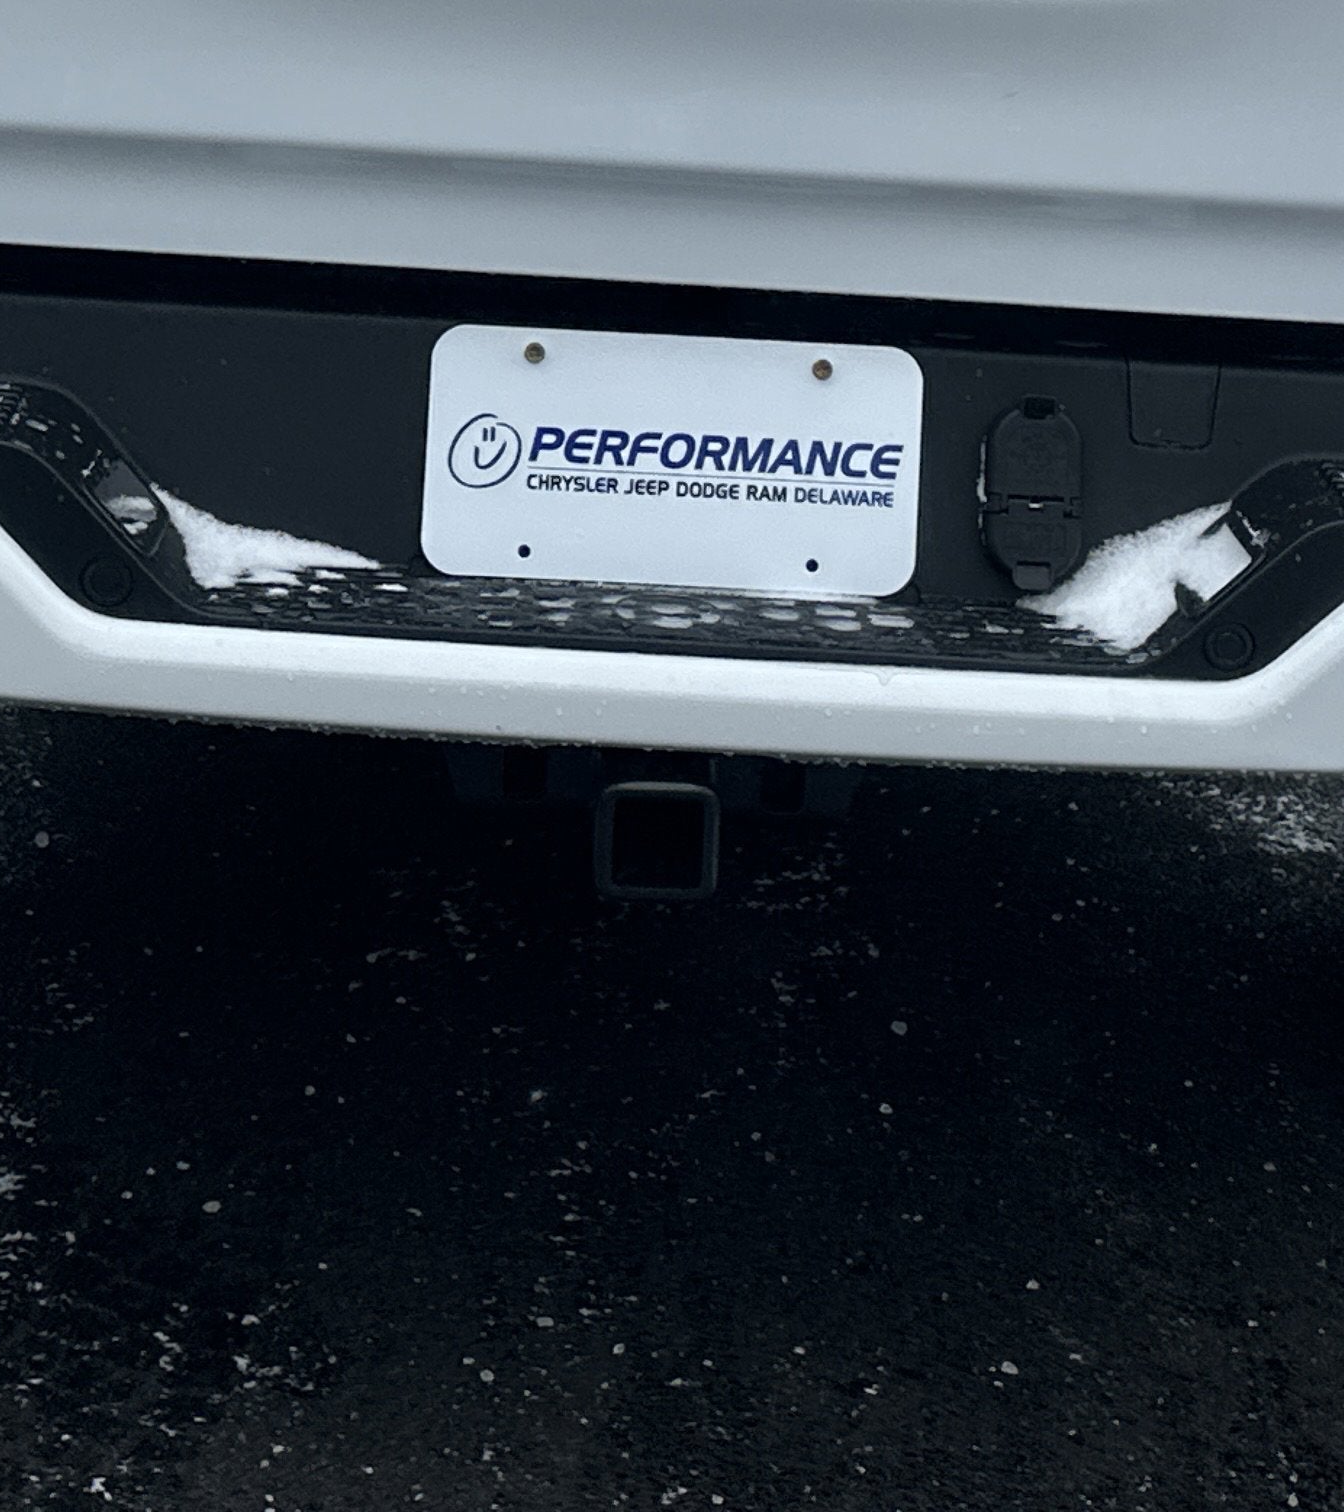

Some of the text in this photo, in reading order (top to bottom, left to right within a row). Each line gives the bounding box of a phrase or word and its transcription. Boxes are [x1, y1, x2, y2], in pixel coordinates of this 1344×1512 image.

[528, 426, 904, 480] PERFORMANCE
[526, 473, 895, 508] CHRYSLER JEEP DODGE RAM DELAWARE
